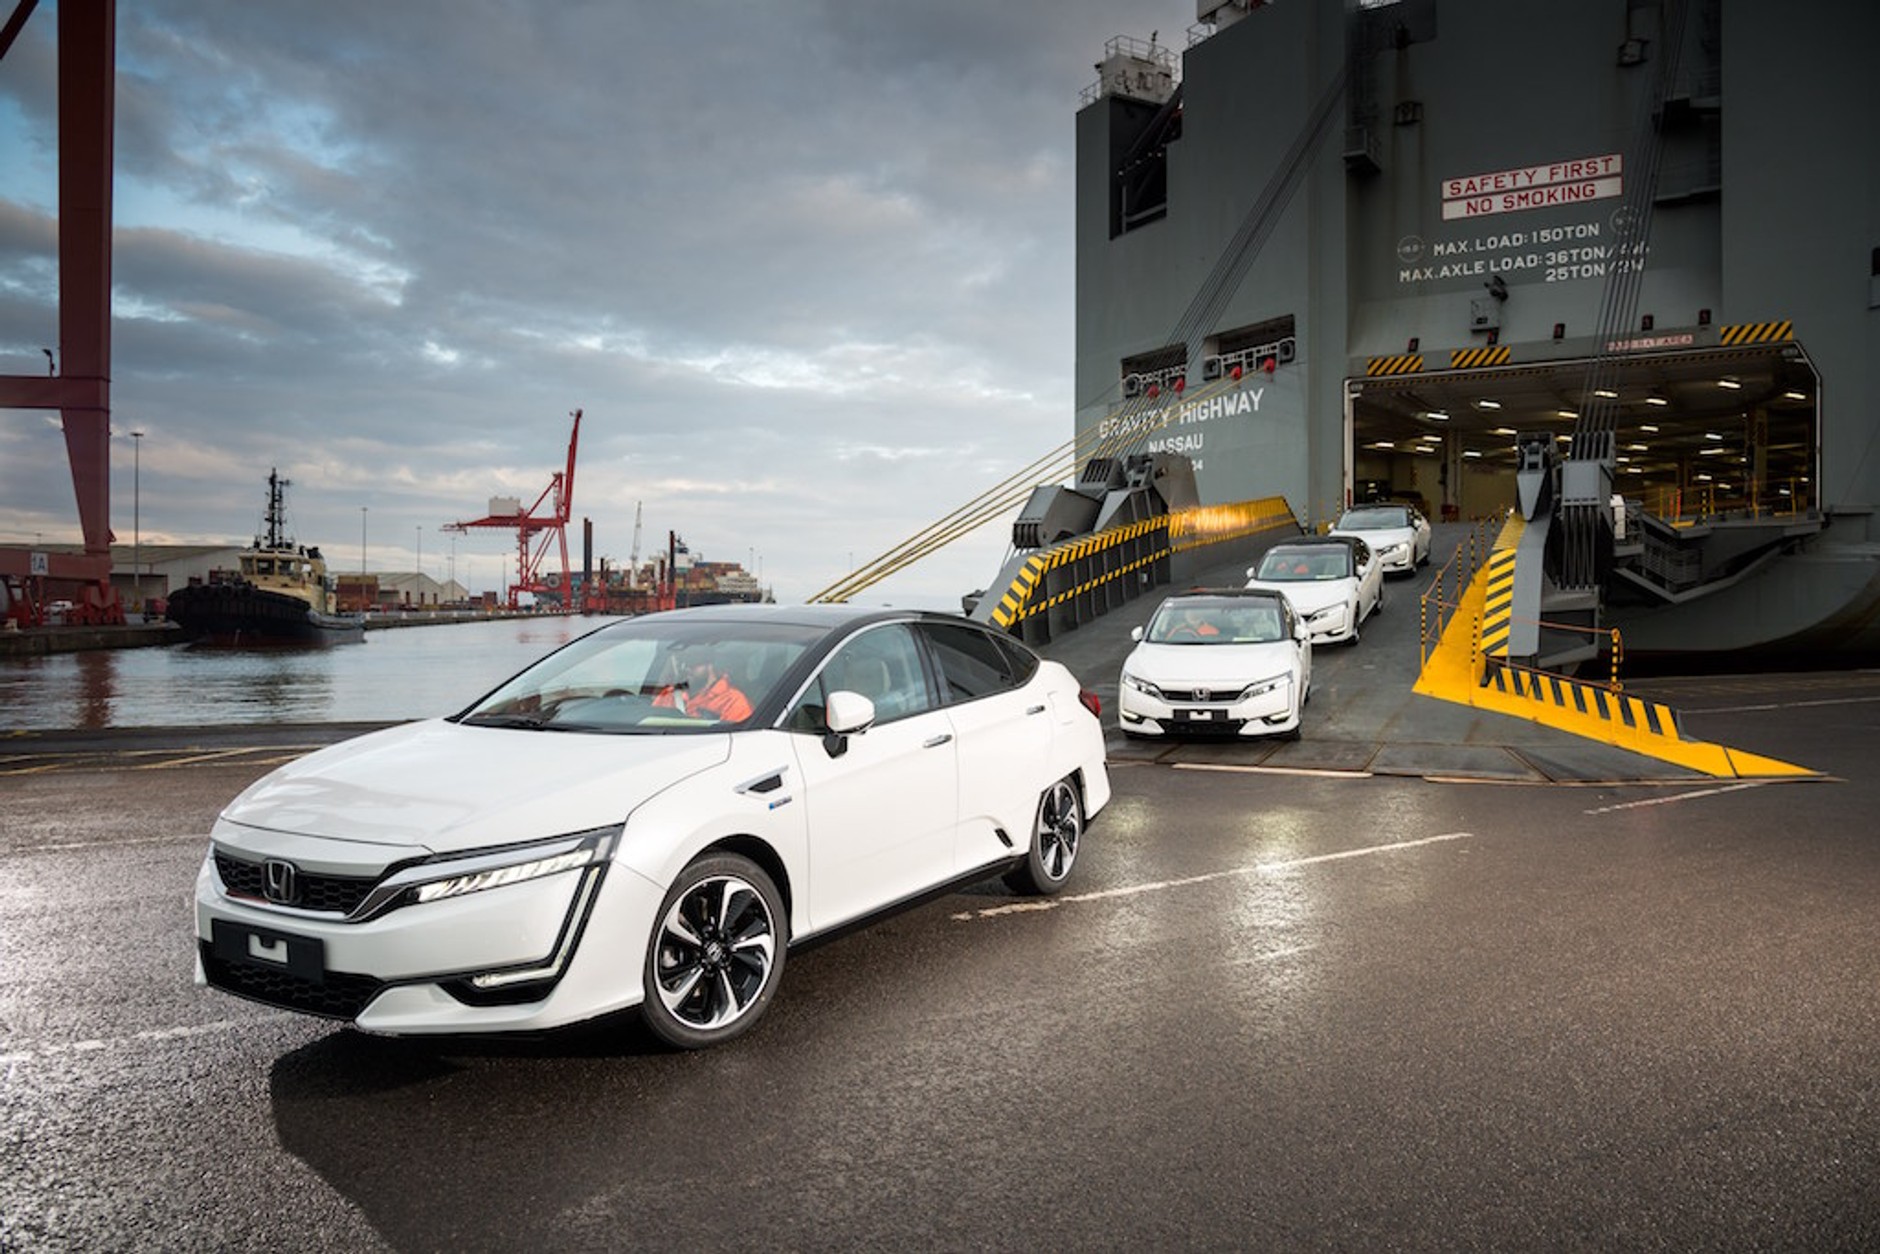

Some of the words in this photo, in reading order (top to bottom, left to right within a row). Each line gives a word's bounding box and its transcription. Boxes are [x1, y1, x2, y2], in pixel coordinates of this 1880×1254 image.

[1450, 169, 1538, 196] SAFETY
[1550, 157, 1614, 182] FIRST
[1466, 198, 1493, 214] NO
[1503, 182, 1596, 209] SMOKING
[1179, 388, 1264, 425] HIGHWAY
[1149, 433, 1203, 454] NASSAU
